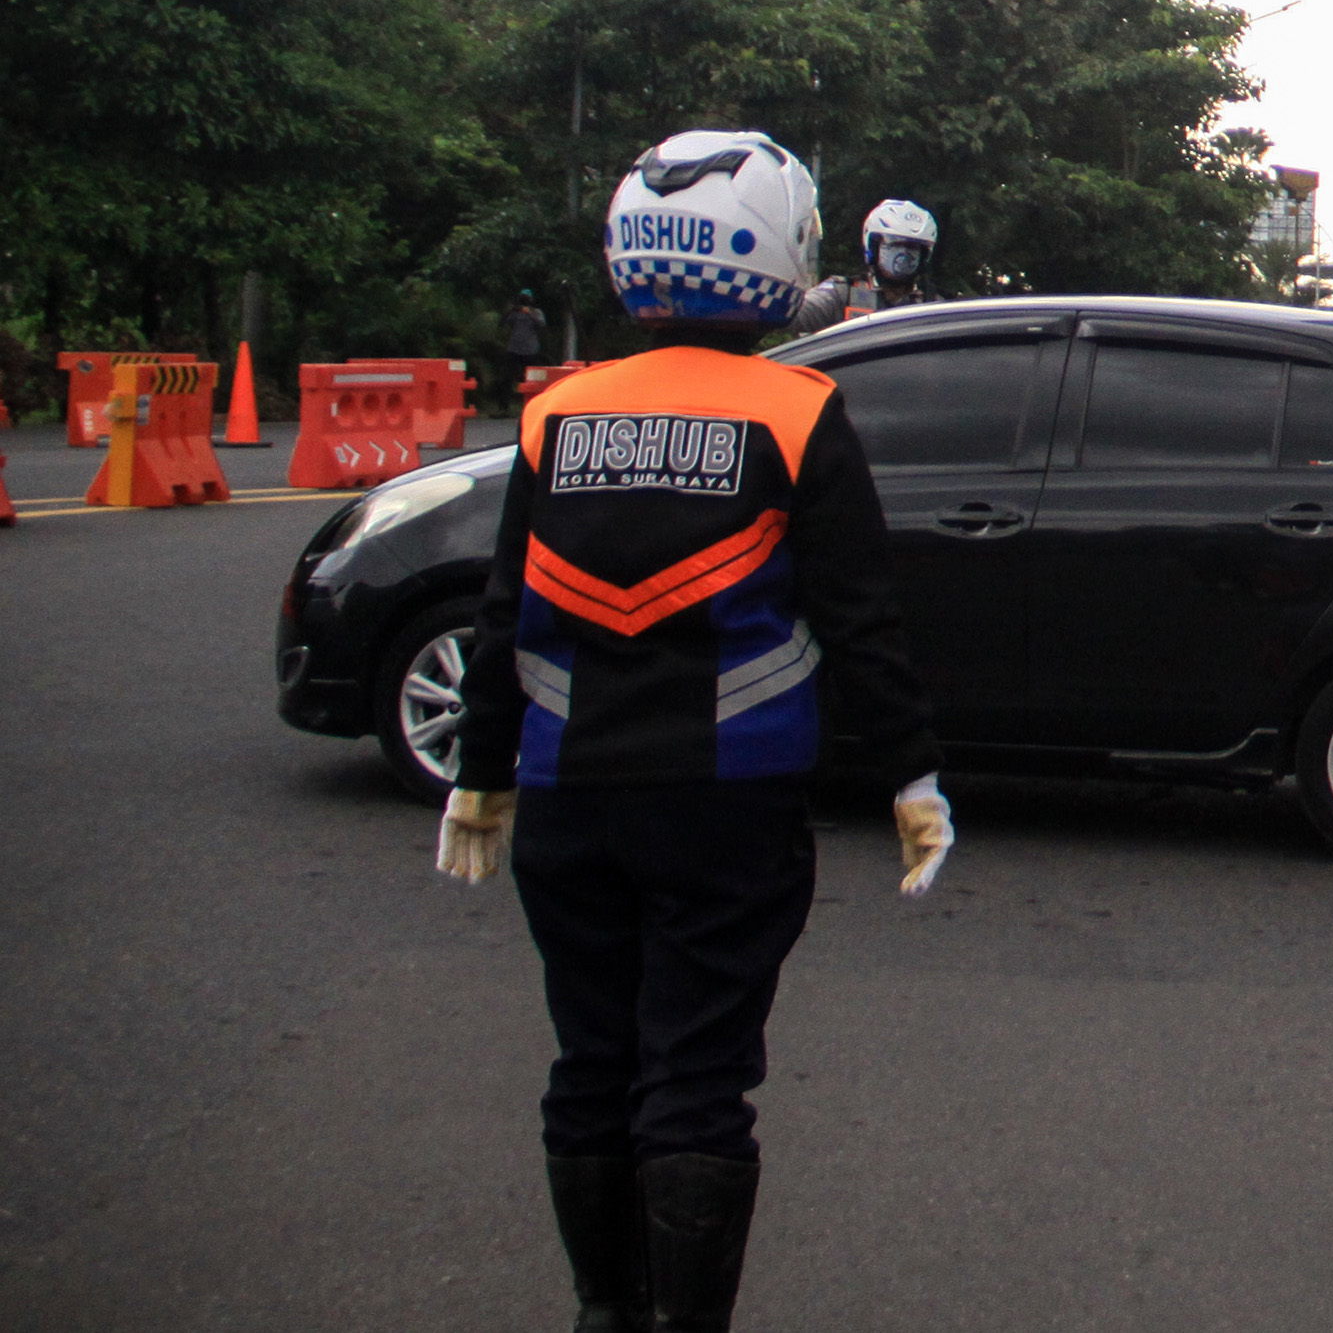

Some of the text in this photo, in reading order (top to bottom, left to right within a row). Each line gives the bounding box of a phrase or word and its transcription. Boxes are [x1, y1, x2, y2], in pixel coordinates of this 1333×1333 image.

[620, 214, 715, 255] DISHUB
[560, 418, 737, 473] DISHUB
[558, 473, 732, 490] KOTA SURABAYA
